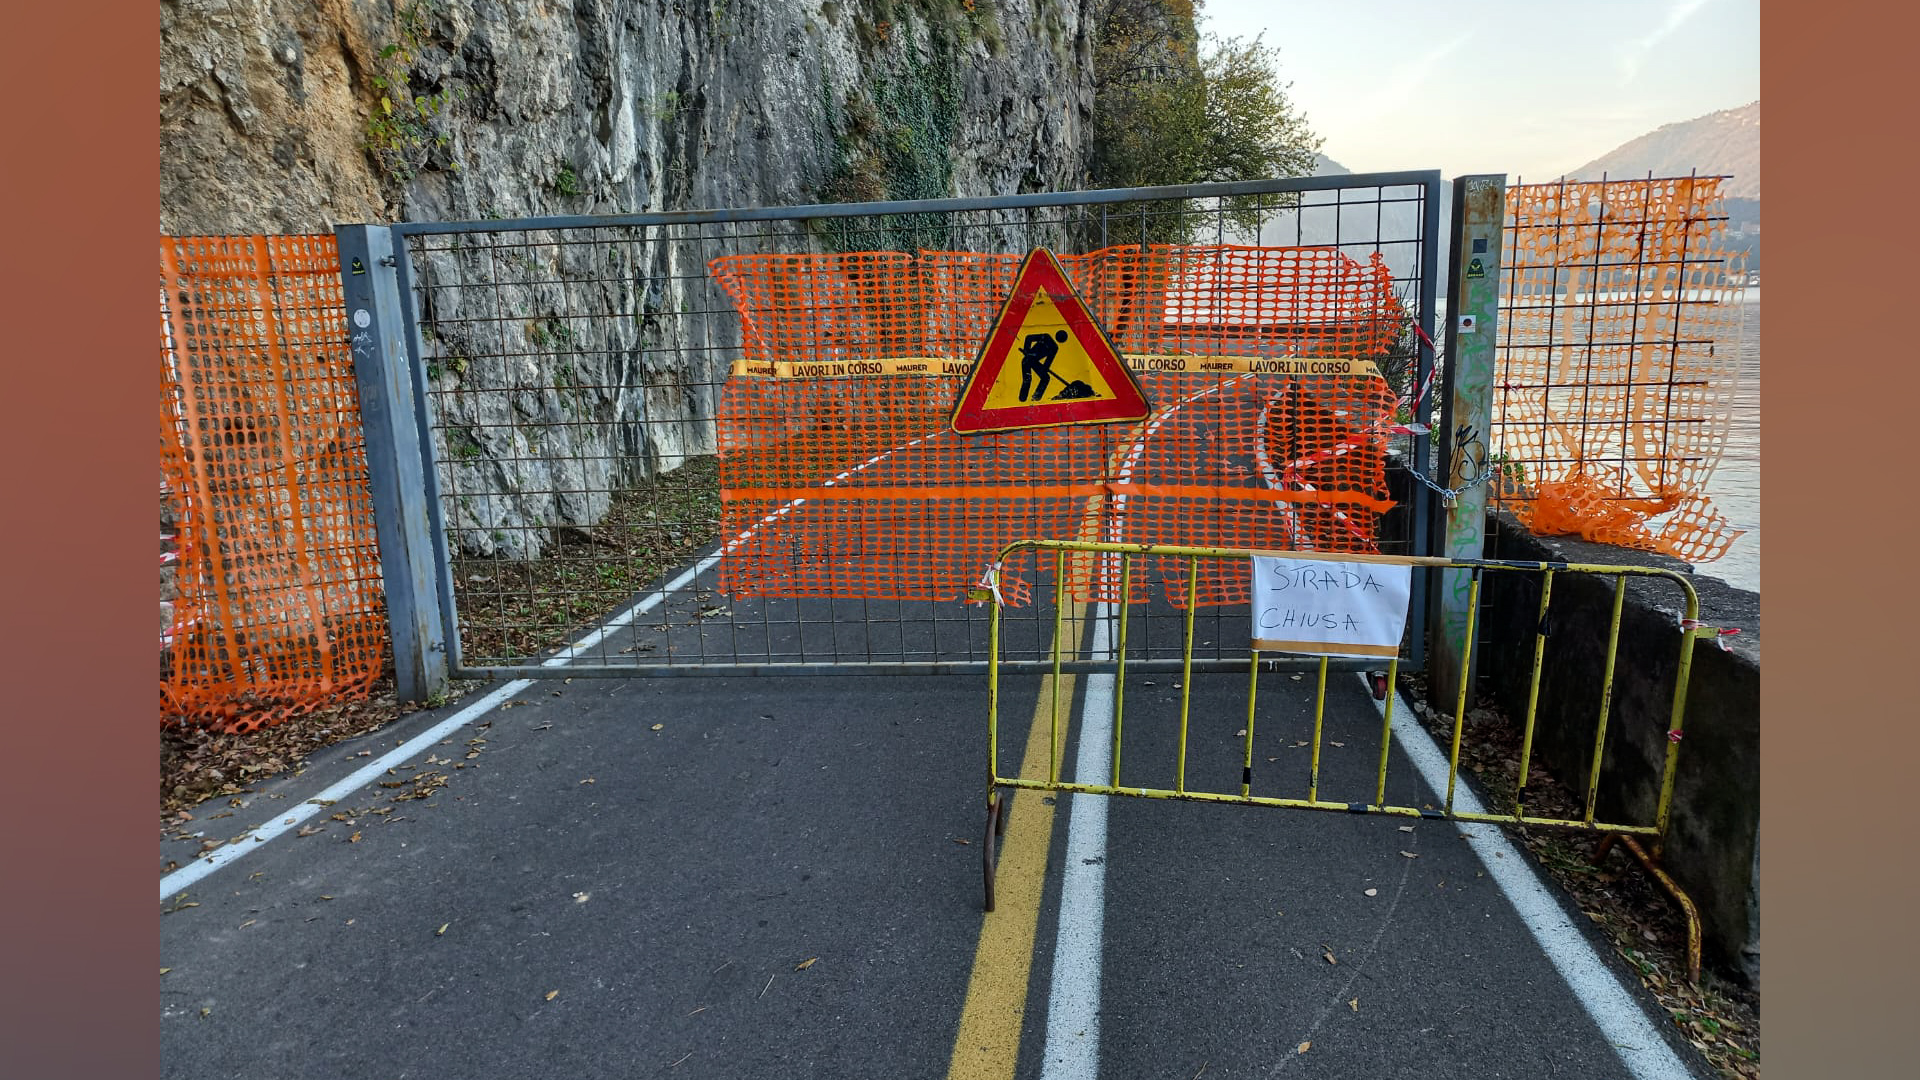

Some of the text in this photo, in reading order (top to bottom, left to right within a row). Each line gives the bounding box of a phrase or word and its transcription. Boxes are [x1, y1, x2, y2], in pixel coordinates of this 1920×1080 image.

[747, 366, 776, 376] MAURER
[791, 365, 829, 377] LAVORI
[832, 364, 845, 375] IN
[848, 362, 883, 375] CORSO
[896, 363, 928, 373] MAURER
[942, 362, 970, 375] LAVO
[1132, 358, 1145, 370] IN
[1148, 359, 1186, 371] CORSO
[1200, 362, 1233, 370] MAURER
[1249, 360, 1291, 373] LAVORI
[1295, 361, 1308, 373] IN
[1310, 361, 1351, 374] CORSO
[1271, 564, 1385, 593] STRADA
[1259, 607, 1361, 631] CHIUSA
